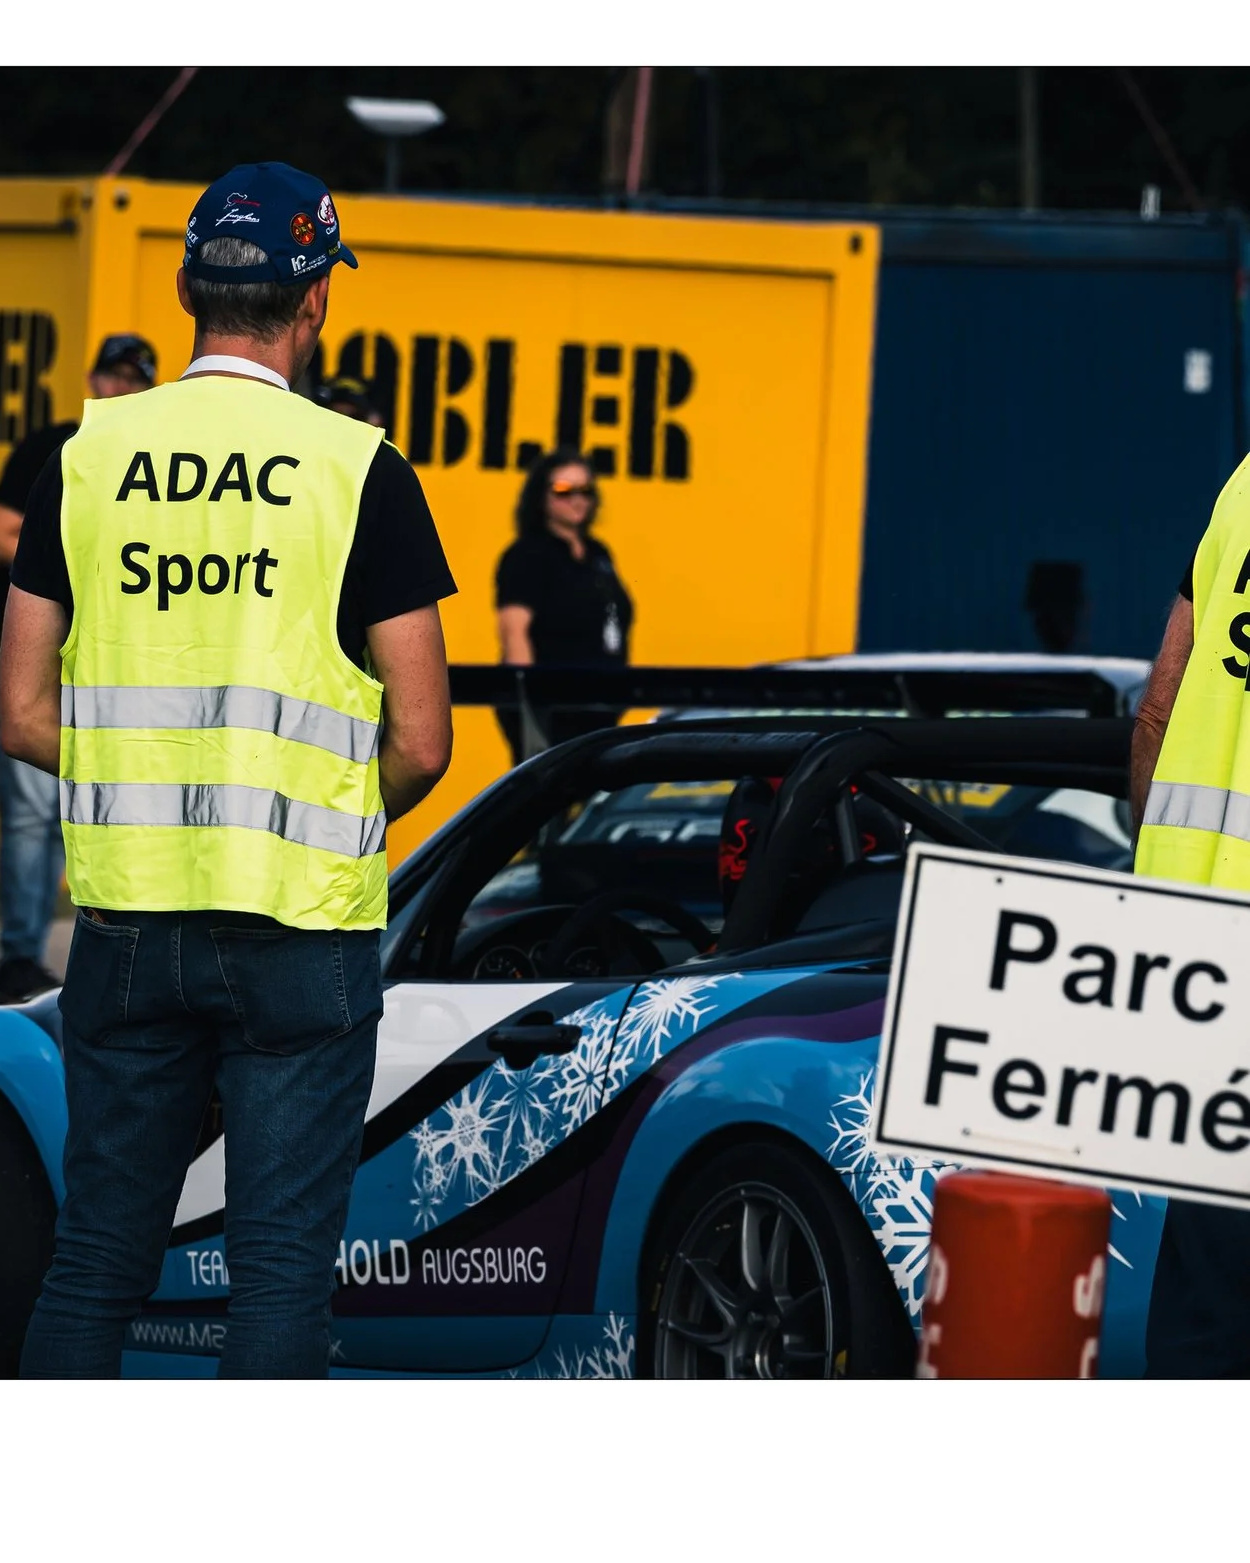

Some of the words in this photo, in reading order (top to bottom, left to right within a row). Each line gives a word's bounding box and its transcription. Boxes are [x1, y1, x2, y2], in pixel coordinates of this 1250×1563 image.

[306, 328, 695, 482] OBLER
[115, 451, 301, 506] ADAC
[120, 541, 279, 611] Sport
[989, 908, 1229, 1023] Parc
[923, 1023, 1250, 1154] Fermé
[422, 1246, 548, 1286] AUGSBURG
